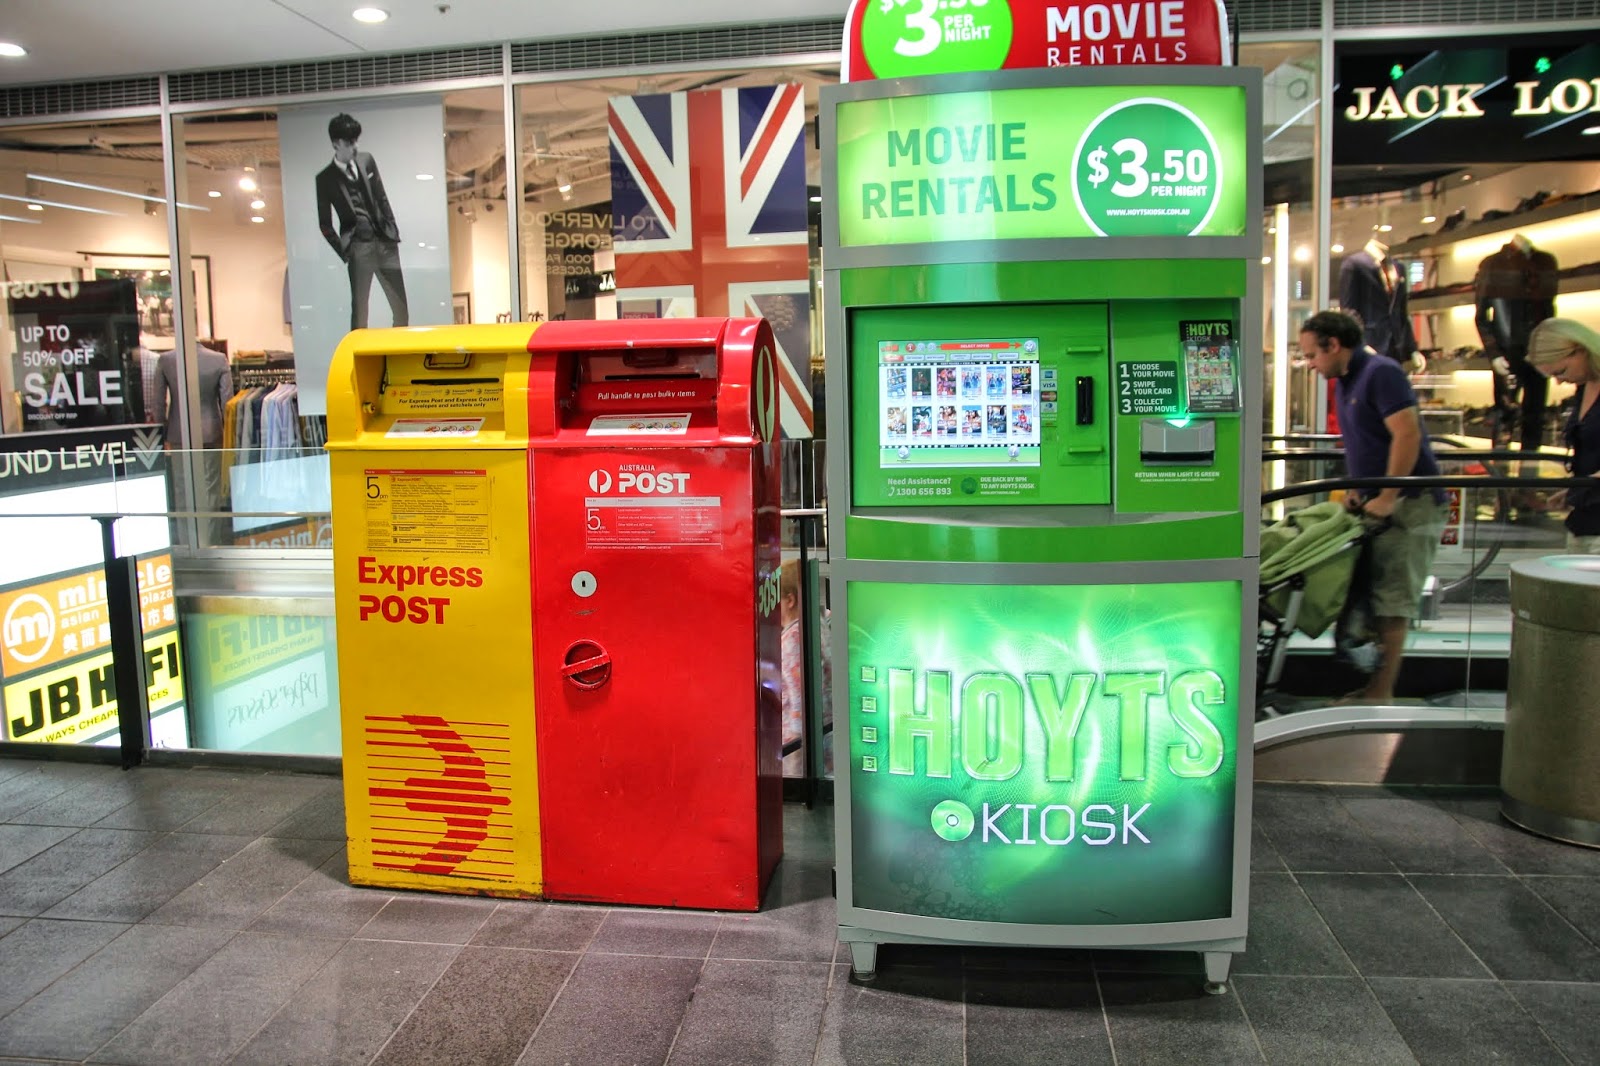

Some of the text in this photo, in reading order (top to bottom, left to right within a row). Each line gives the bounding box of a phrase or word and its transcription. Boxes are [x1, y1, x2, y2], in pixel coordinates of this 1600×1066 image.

[943, 14, 974, 28] PER
[1045, 1, 1185, 43] MOVIE
[945, 25, 991, 43] NIGHT
[1047, 42, 1187, 66] RENTALS
[1344, 77, 1600, 121] JACK LO
[887, 122, 1026, 168] MOVIE
[1087, 138, 1208, 197] $3.50
[862, 172, 1057, 219] RENTALS
[1151, 185, 1208, 197] PER NIGHT
[20, 324, 70, 343] UP TO
[1189, 322, 1230, 336] HOYTS
[23, 348, 95, 367] 50% OFF
[1120, 363, 1160, 378] 1 CHOOSE
[1133, 370, 1152, 378] YOUR
[24, 370, 124, 408] SALE
[597, 392, 610, 400] Pull
[1121, 381, 1131, 395] 2
[1153, 387, 1172, 395] CARD
[1122, 398, 1132, 413] 3
[1134, 405, 1154, 413] YOUR
[60, 441, 137, 471] LEVEL
[618, 472, 691, 494] POST
[907, 477, 952, 485] Assistance?
[896, 487, 952, 496] 1300 656 893
[358, 556, 483, 591] Express
[60, 589, 173, 629] asian plaza
[359, 595, 450, 624] POST
[11, 676, 80, 738] JB
[888, 668, 1225, 782] HOYTS
[982, 803, 1152, 846] KIOSK
